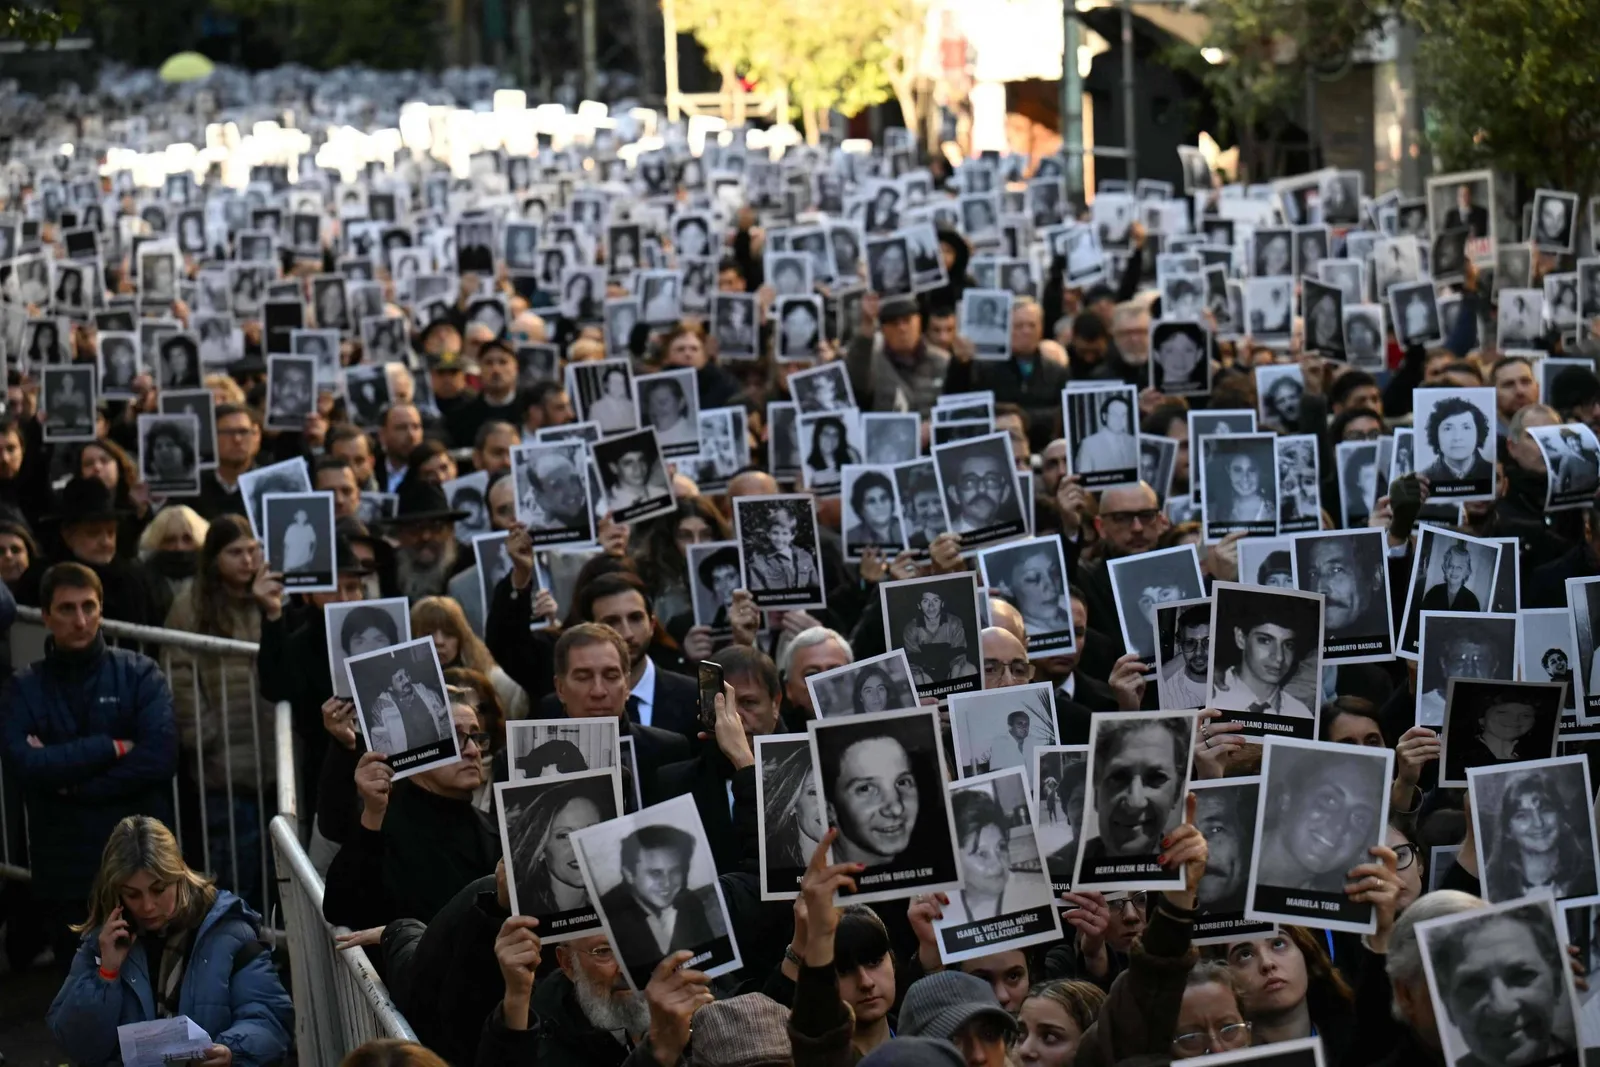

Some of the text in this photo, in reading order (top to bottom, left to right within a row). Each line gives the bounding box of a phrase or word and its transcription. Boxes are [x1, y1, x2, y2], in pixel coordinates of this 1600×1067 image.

[1328, 643, 1356, 652] NORBERTO
[1357, 641, 1383, 650] BASIGLIO
[933, 685, 953, 695] ZÁRATE
[953, 681, 973, 691] LOAYZA
[1263, 722, 1294, 733] BRIKMAN
[392, 748, 439, 767] OLEGARIO RAMÍREZ
[1136, 863, 1145, 872] DE
[860, 867, 933, 885] AGUSTÍN DIEGO LEW
[1051, 882, 1070, 890] SILVIA
[1285, 897, 1340, 911] MARIELA TOER
[551, 913, 598, 929] RITA WORONA
[956, 912, 1039, 939] ISABEL VICTORIA NÚÑEZ
[1199, 920, 1233, 931] NORBERTO
[974, 925, 1025, 943] DE VELÁZQUEZ
